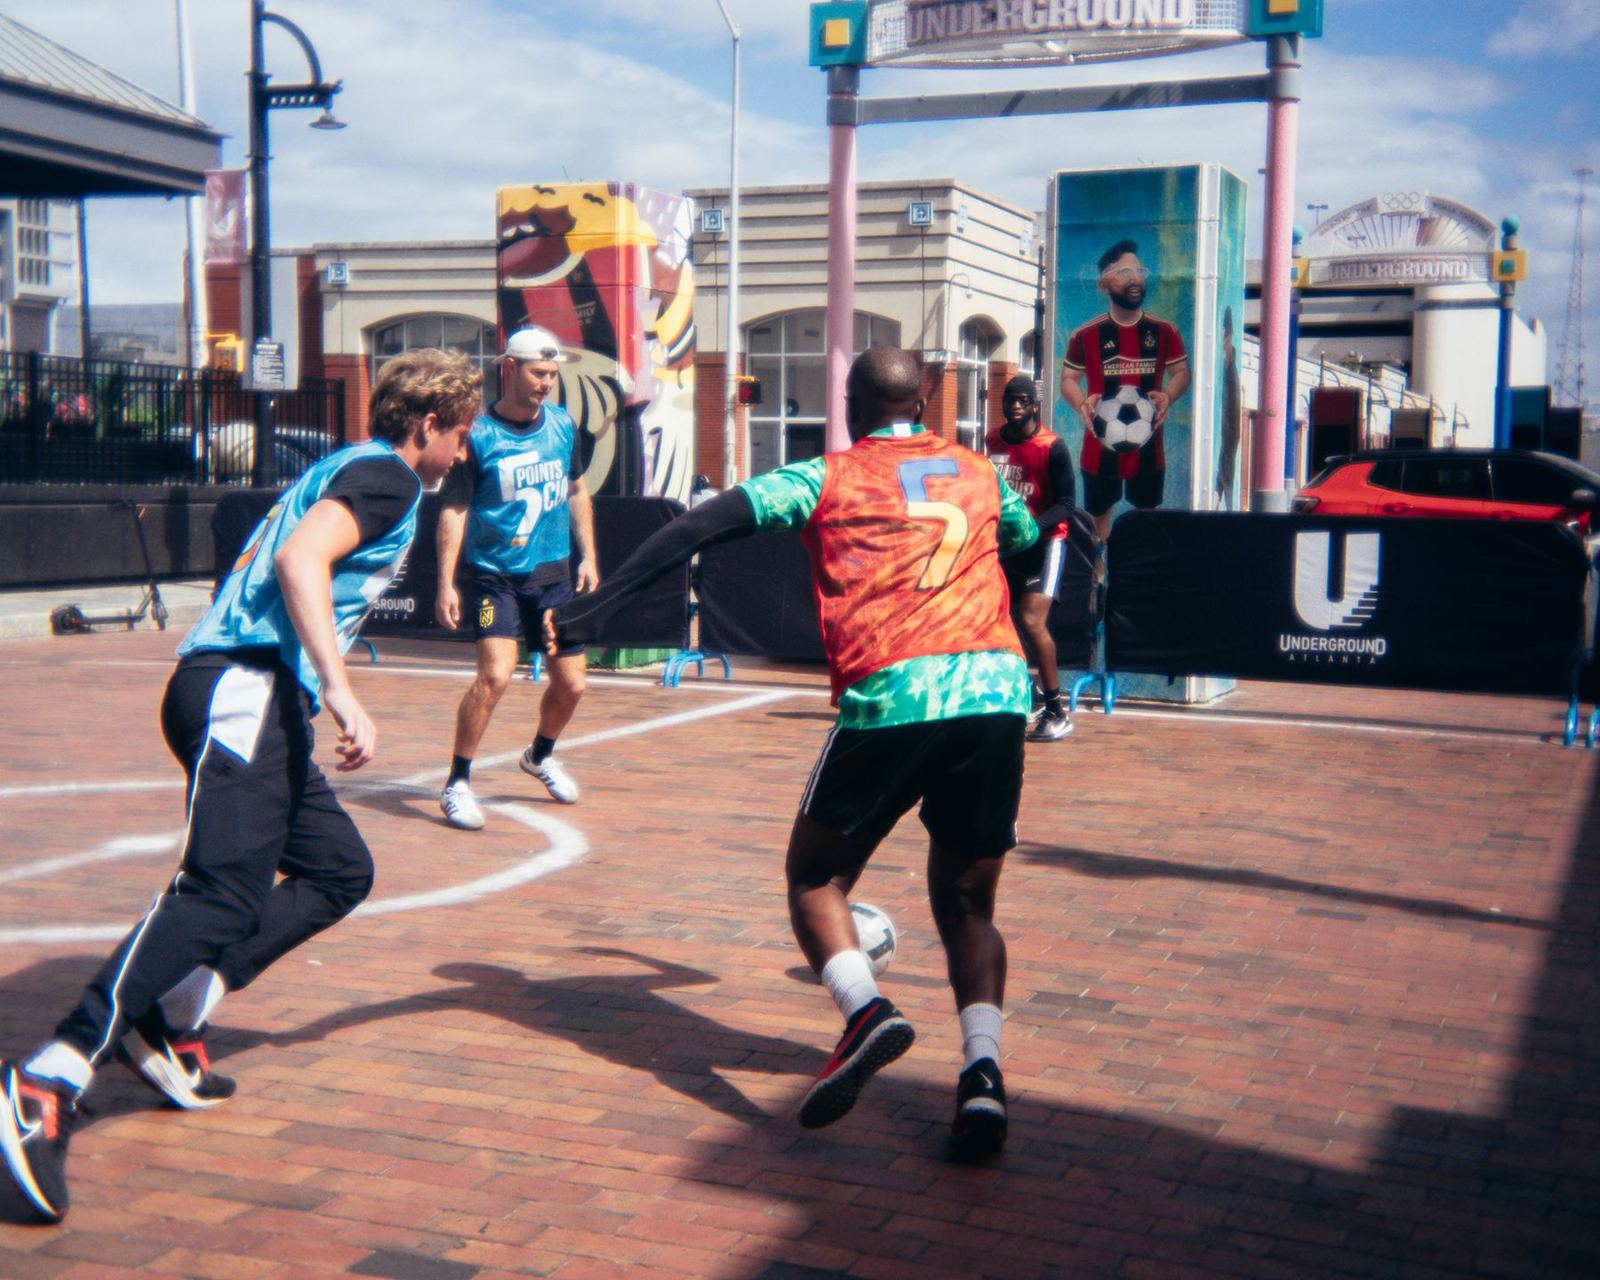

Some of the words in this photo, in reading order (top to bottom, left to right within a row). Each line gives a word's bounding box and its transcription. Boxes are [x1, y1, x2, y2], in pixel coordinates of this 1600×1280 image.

[905, 0, 1193, 45] UNDERGROUND
[516, 460, 563, 488] POINTS
[897, 458, 968, 592] 5
[374, 598, 415, 612] GROUND
[1280, 634, 1386, 655] UNDERGROUND
[1288, 653, 1376, 664] ATLANTA
